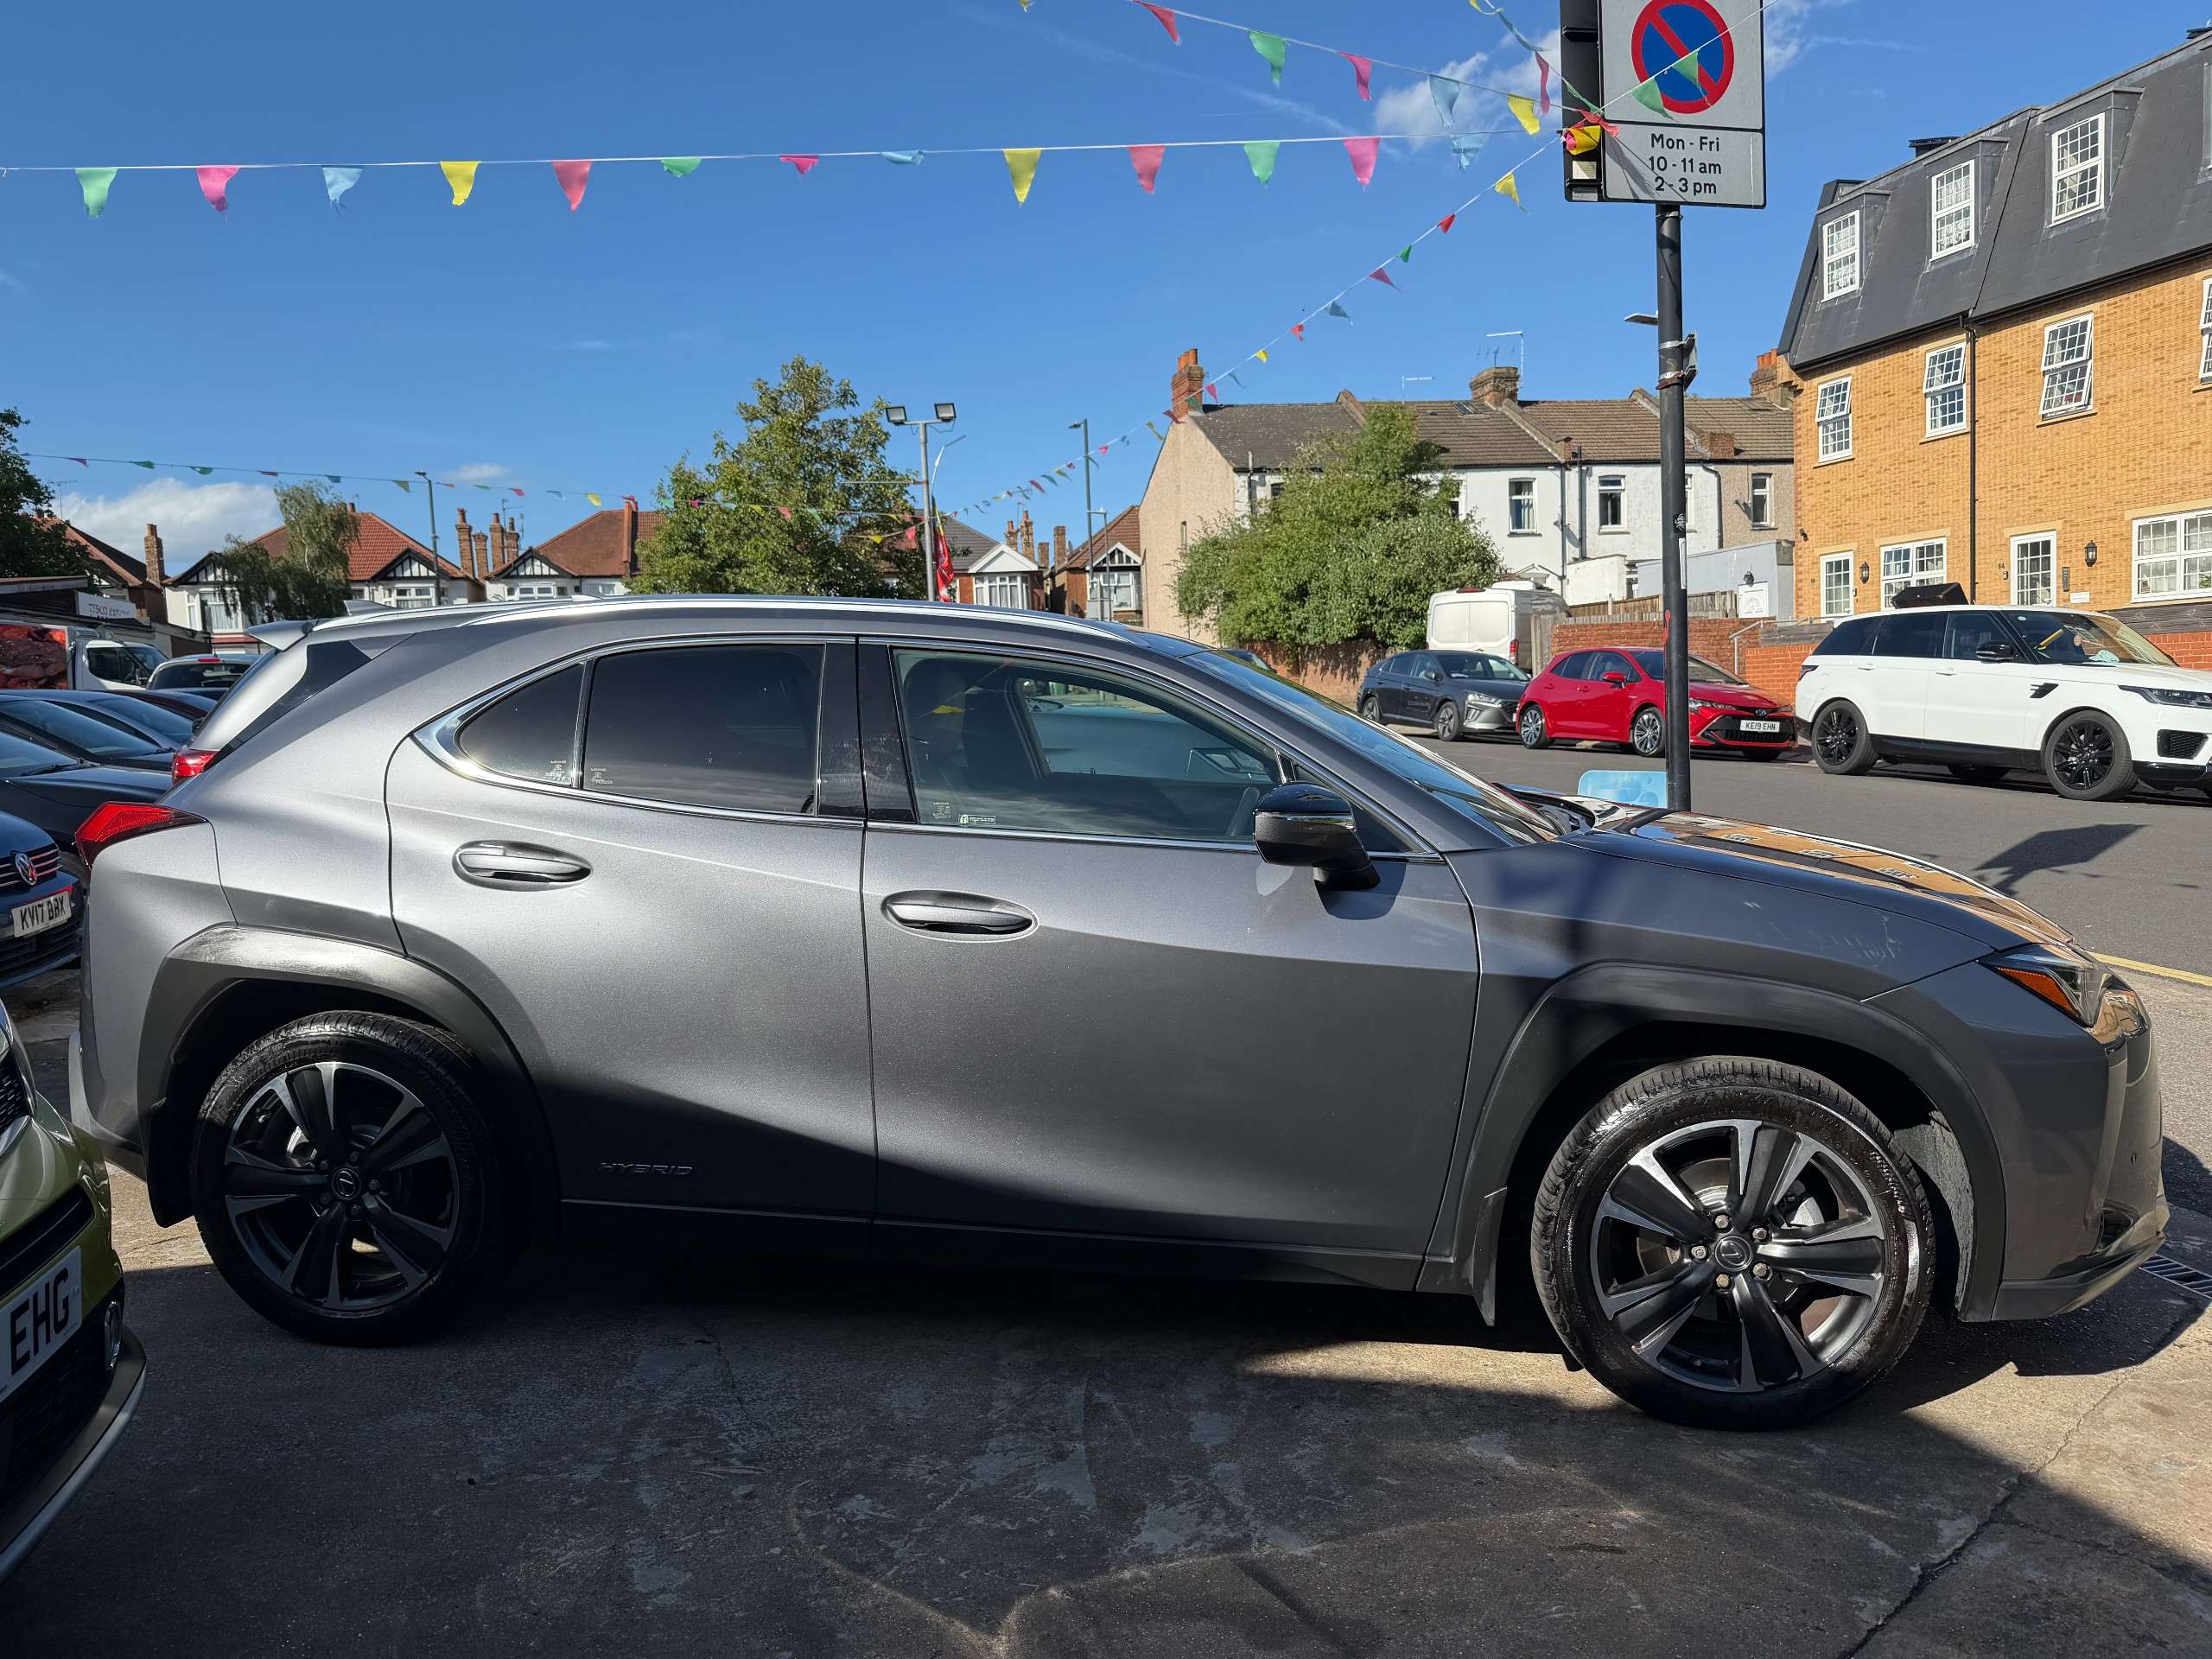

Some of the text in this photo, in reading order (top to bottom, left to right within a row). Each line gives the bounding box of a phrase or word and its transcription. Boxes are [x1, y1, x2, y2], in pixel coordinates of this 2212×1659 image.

[1650, 133, 1685, 150] Mon
[1700, 136, 1719, 151] Fri
[1649, 156, 1668, 171] 10
[1681, 157, 1694, 173] 11
[1699, 162, 1721, 175] am
[1655, 176, 1664, 191] 2
[1678, 177, 1688, 193] 3
[1694, 181, 1717, 195] pm
[1745, 721, 1776, 731] KE19 EHN
[20, 902, 44, 931] KV17
[10, 1267, 70, 1376] EHG
